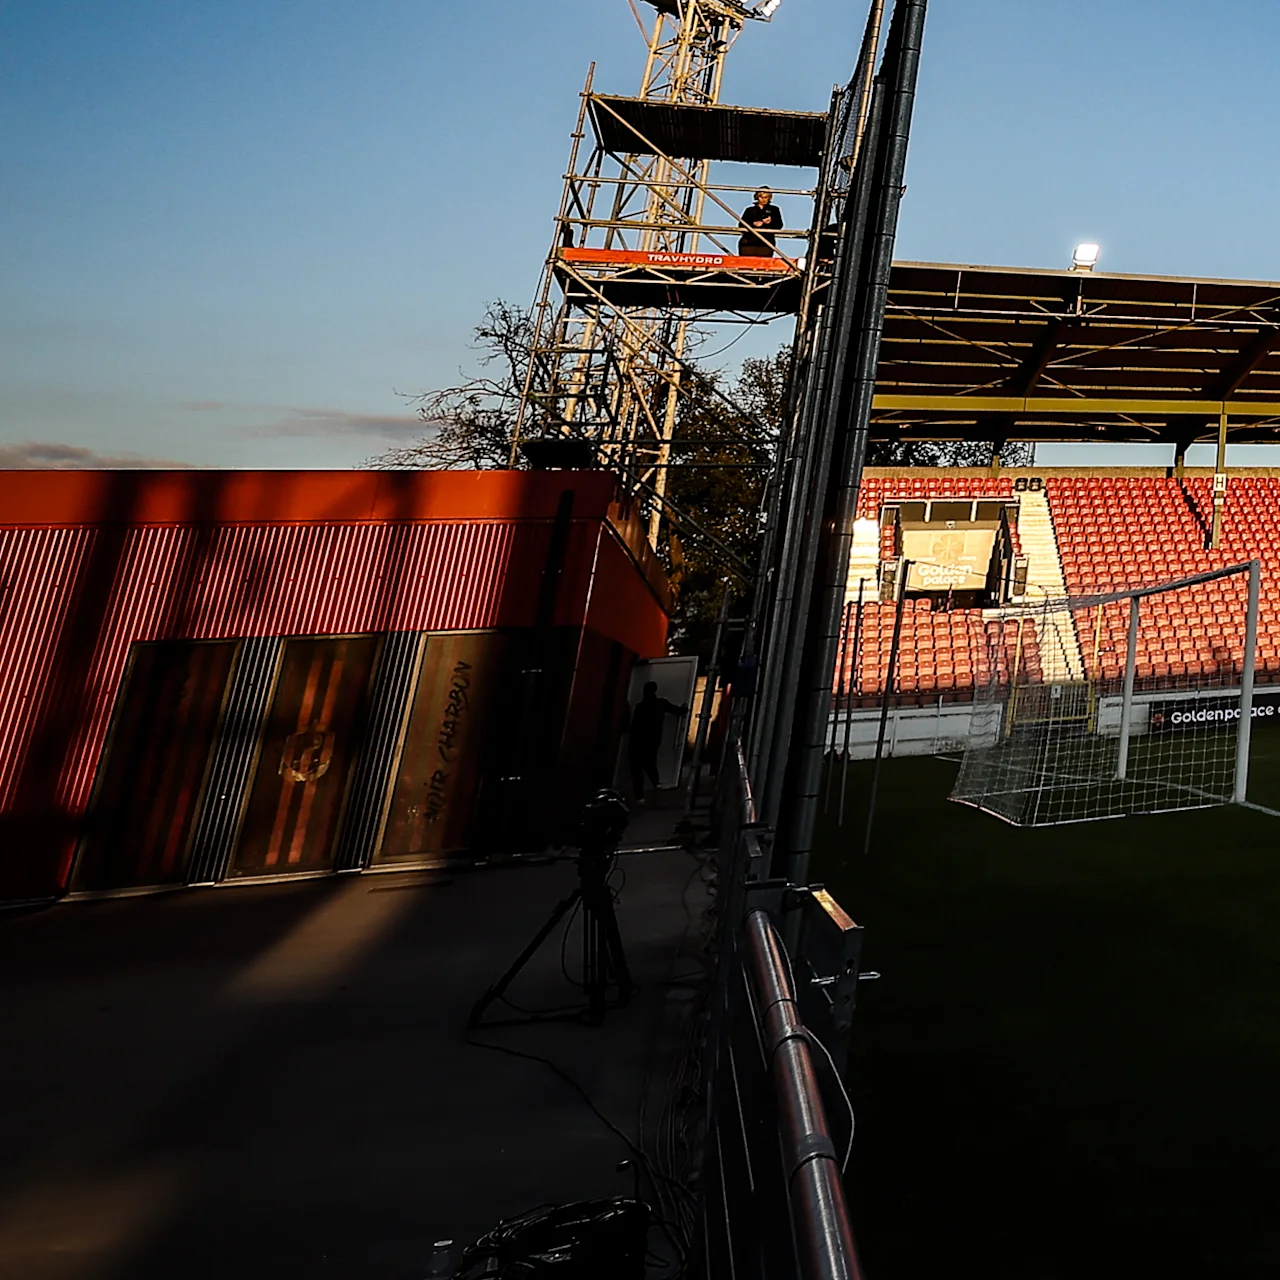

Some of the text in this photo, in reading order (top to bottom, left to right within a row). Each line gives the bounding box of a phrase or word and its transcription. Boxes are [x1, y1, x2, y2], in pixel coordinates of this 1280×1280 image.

[648, 253, 723, 265] TRAVHYDRO
[1215, 476, 1223, 488] H
[917, 563, 973, 578] Golden
[922, 575, 967, 587] palace
